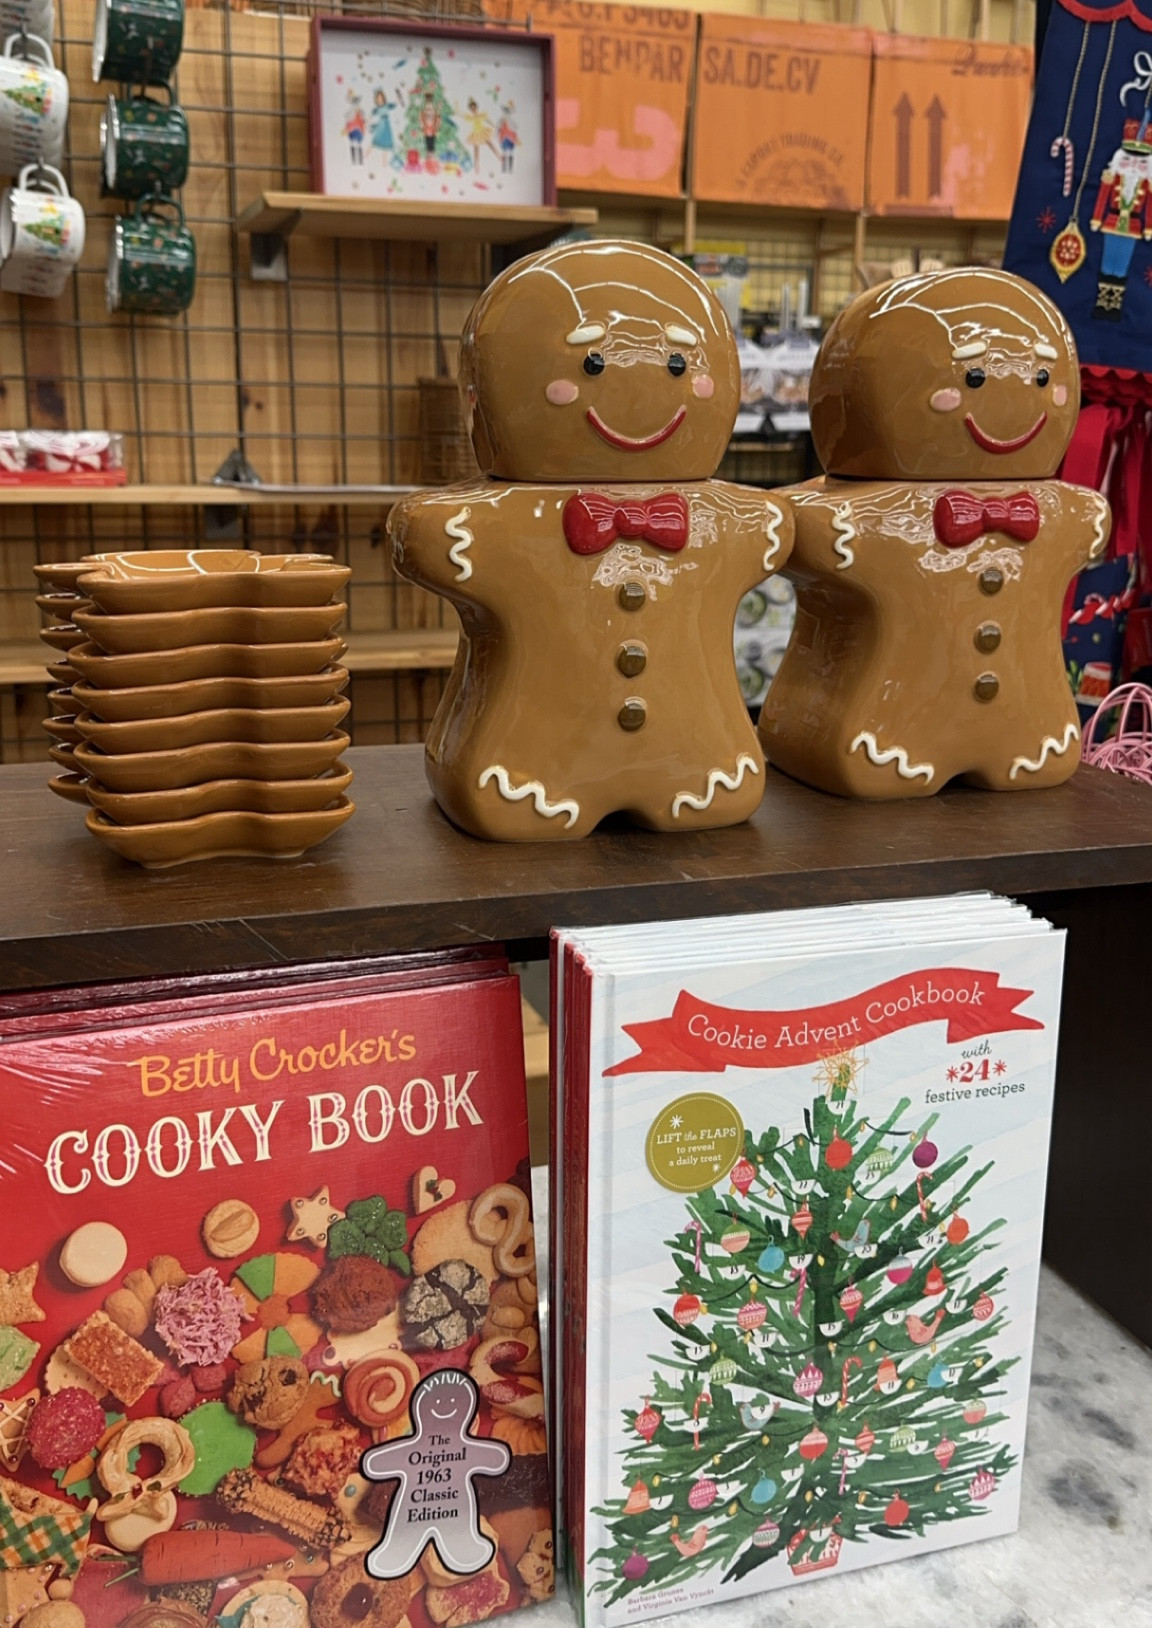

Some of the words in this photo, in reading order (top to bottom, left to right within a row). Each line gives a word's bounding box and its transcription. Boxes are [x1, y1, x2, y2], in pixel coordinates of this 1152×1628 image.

[688, 1014, 767, 1049] Cookie
[774, 1017, 861, 1048] Advent
[865, 981, 985, 1024] Cookbook
[961, 1039, 992, 1059] with
[134, 1048, 240, 1097] Betty
[250, 1029, 416, 1081] Crocker's
[925, 1089, 971, 1104] festive
[975, 1083, 1025, 1098] recipes
[44, 1101, 285, 1194] COOKY
[306, 1070, 484, 1153] BOOK
[656, 1132, 682, 1144] LIFT
[684, 1131, 697, 1141] the
[700, 1127, 736, 1139] FLAPS
[676, 1146, 685, 1154] to
[688, 1141, 715, 1153] reveal
[676, 1156, 698, 1166] daily
[700, 1154, 722, 1163] treat
[428, 1435, 450, 1446] The
[408, 1447, 467, 1467] Original
[417, 1468, 452, 1485] 1963
[411, 1487, 459, 1503] Classic
[407, 1508, 458, 1523] Edition
[628, 1605, 641, 1614] and
